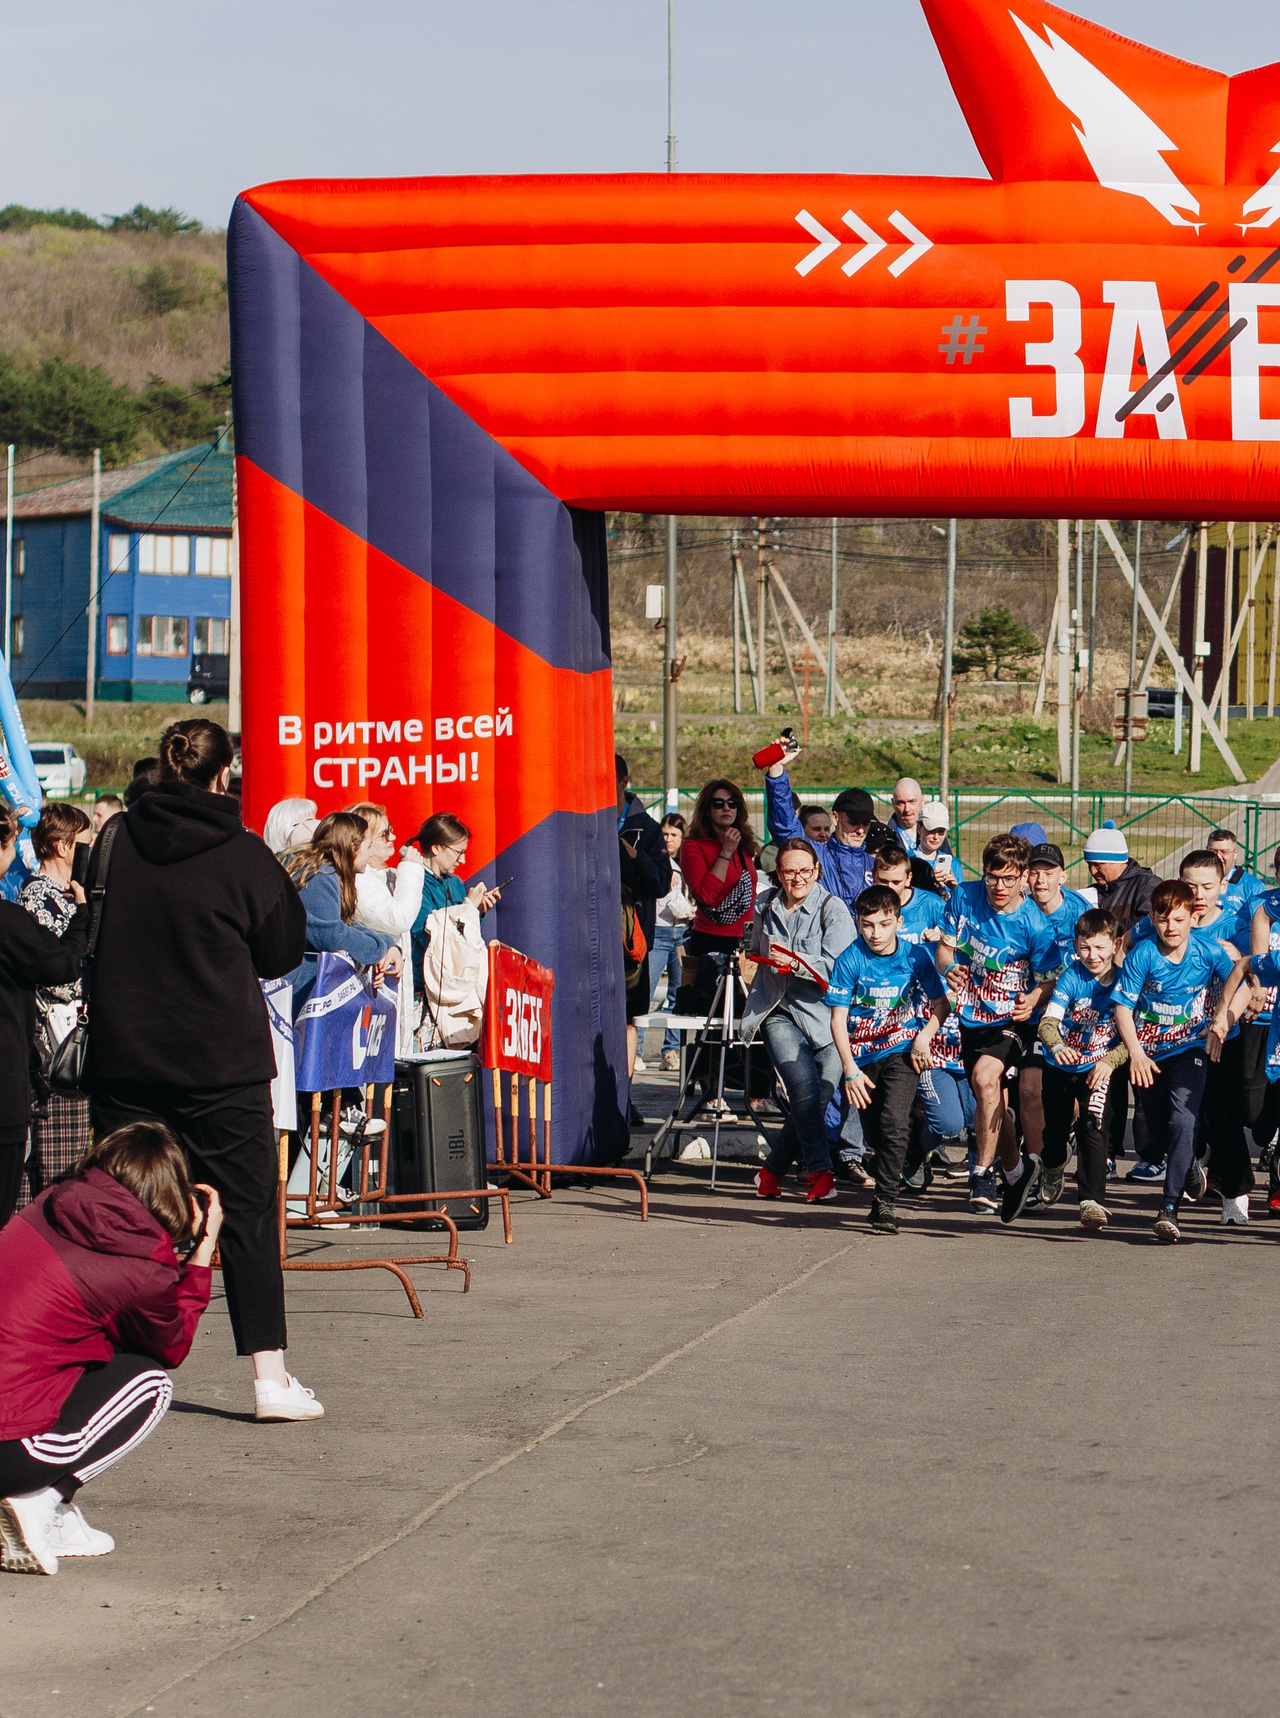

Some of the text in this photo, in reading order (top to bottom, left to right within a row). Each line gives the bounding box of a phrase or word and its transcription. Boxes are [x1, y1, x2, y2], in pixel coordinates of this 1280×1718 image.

[278, 706, 514, 750] В ритме всей
[313, 751, 480, 788] СТРАНЫ!
[995, 1000, 1015, 1015] 202
[448, 1128, 466, 1162] JBL
